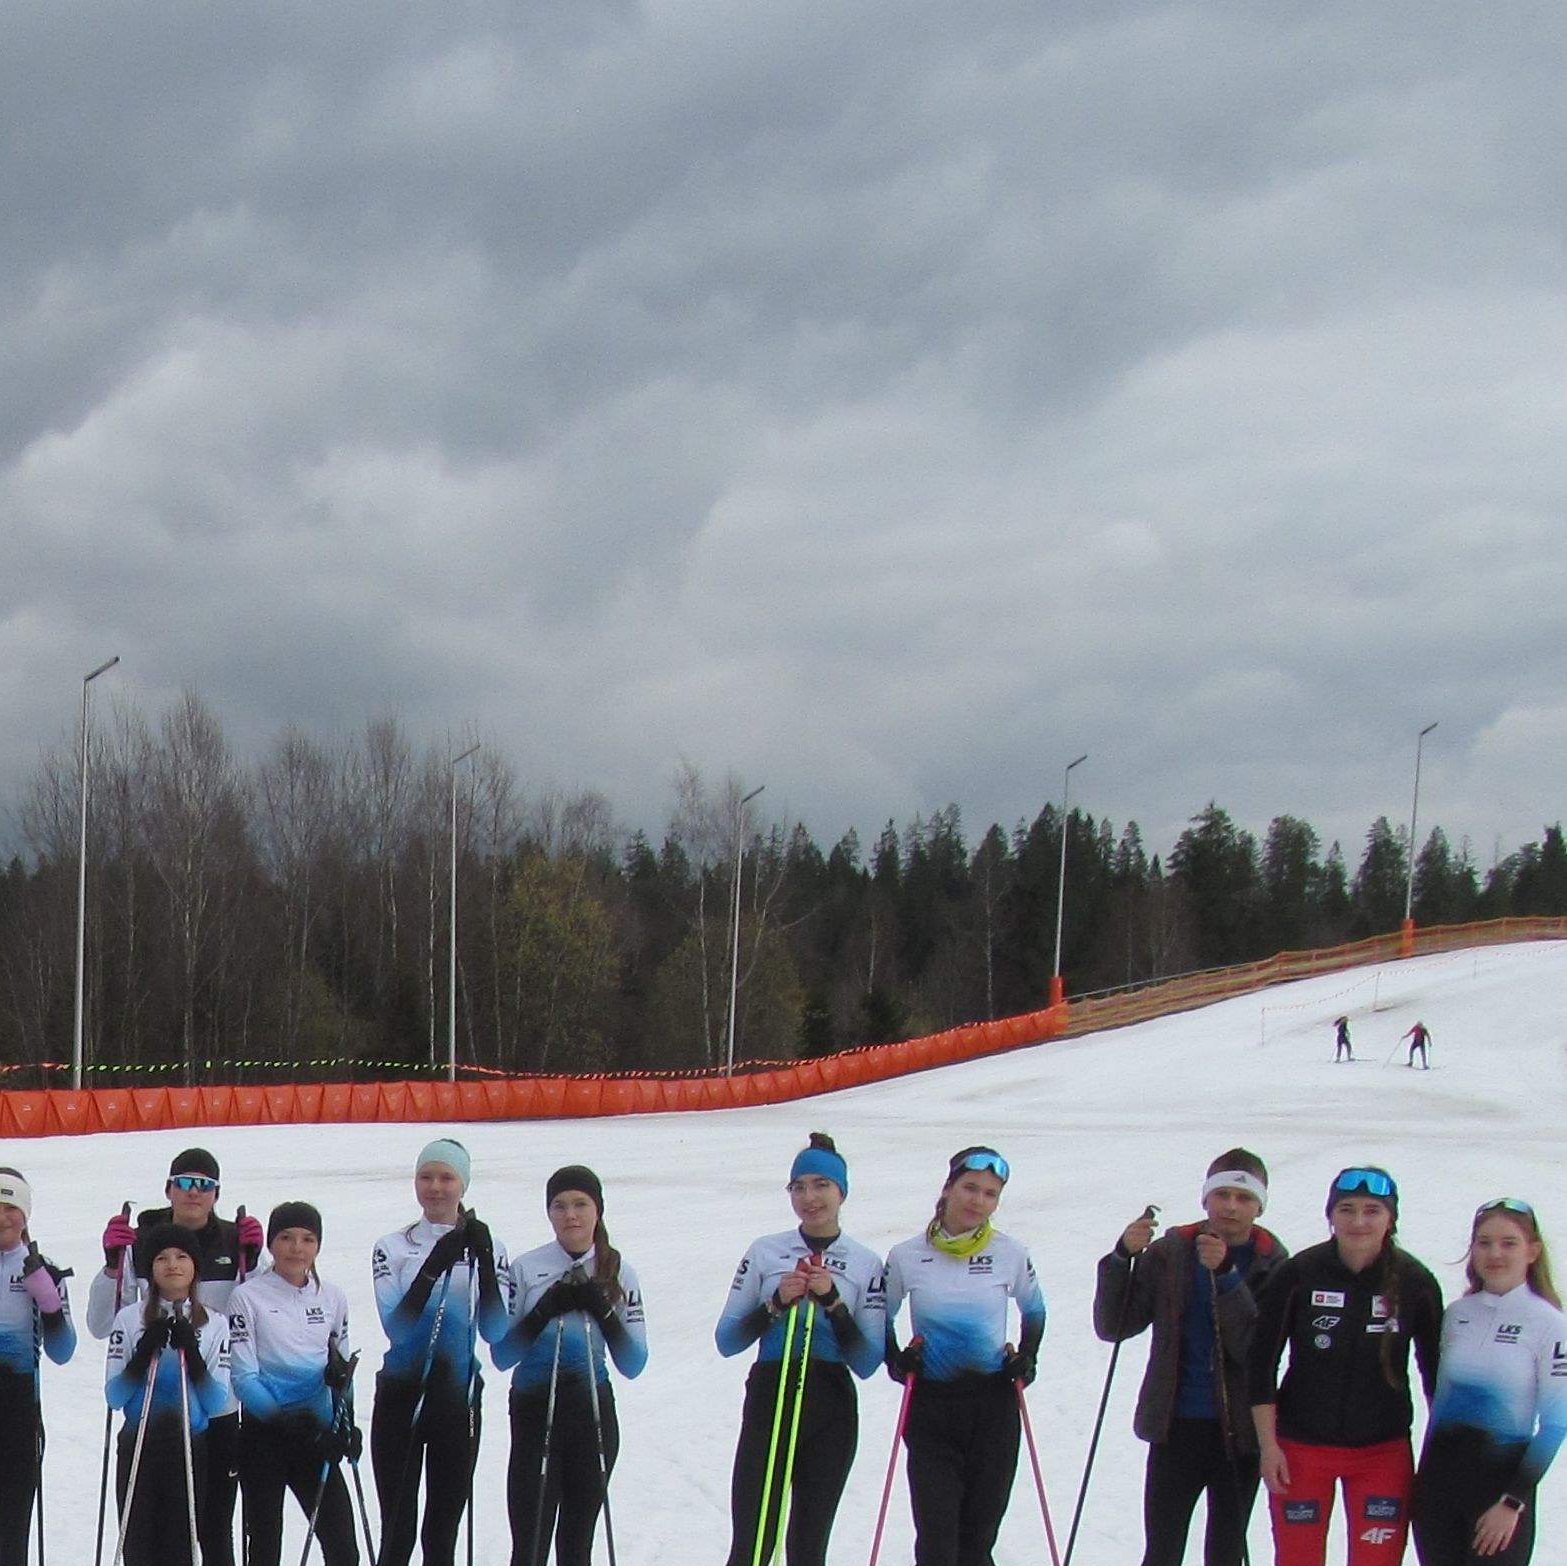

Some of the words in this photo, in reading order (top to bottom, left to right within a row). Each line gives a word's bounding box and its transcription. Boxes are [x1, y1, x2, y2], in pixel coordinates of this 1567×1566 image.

[824, 1256, 847, 1271] LKS
[968, 1255, 994, 1266] LKS
[10, 1274, 25, 1284] LK
[866, 1275, 888, 1294] LK
[305, 1307, 324, 1317] LKS
[229, 1314, 247, 1331] KS
[1497, 1324, 1522, 1335] LKS
[1359, 1527, 1397, 1545] 4F
